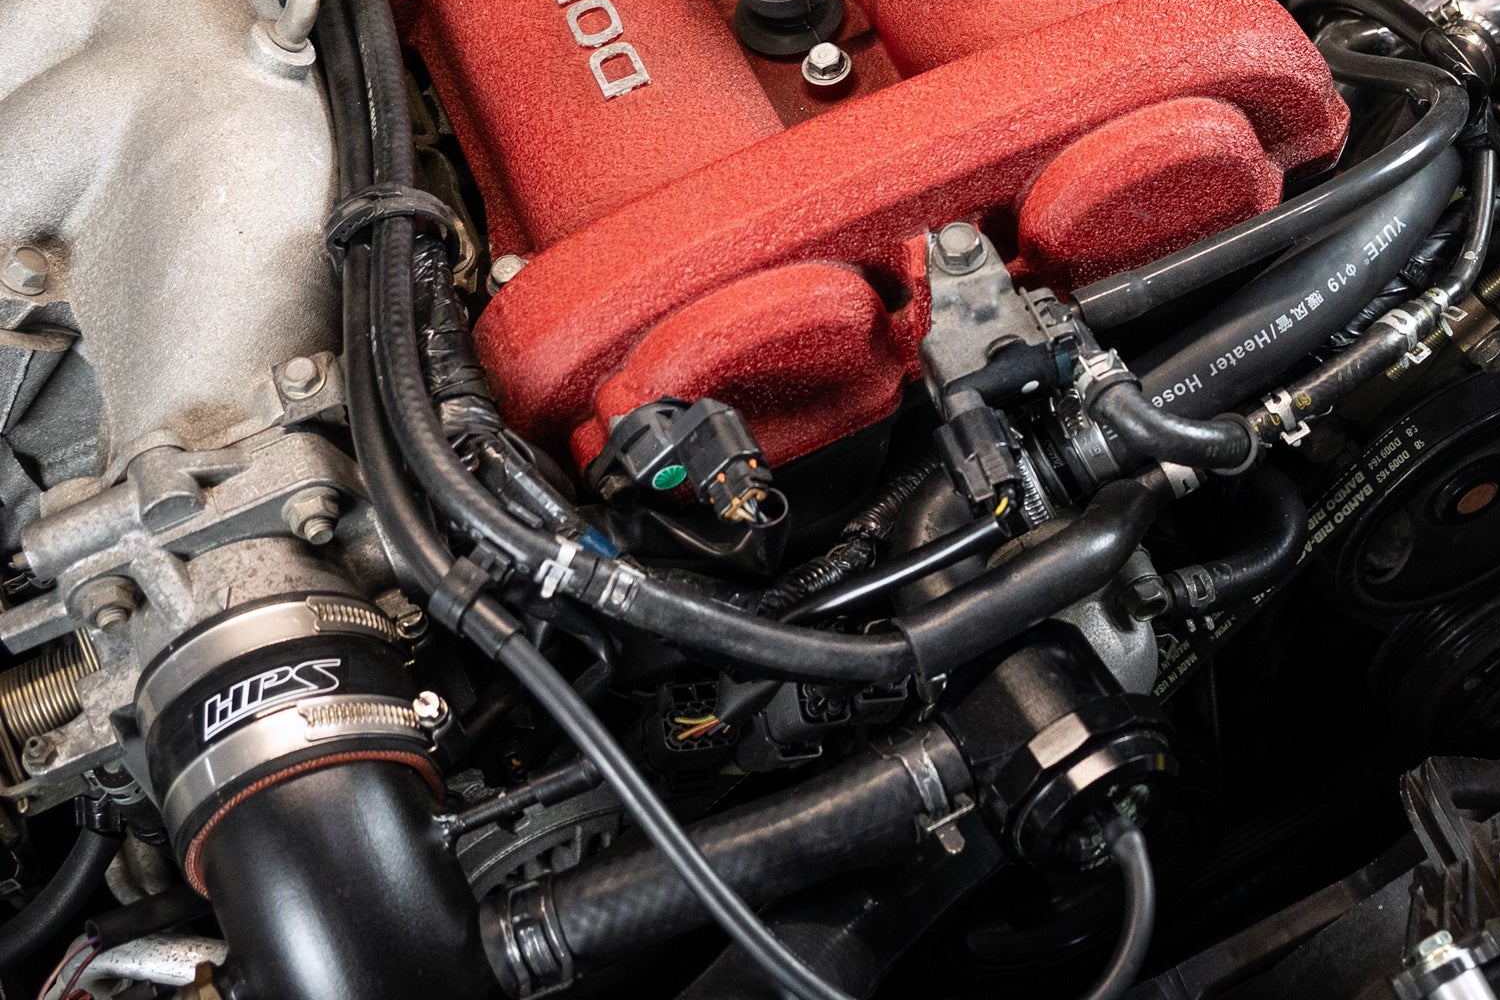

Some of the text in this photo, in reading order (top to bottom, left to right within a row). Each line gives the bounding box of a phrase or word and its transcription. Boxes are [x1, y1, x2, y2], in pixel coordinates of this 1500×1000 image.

[1363, 216, 1407, 262] YUTE
[1152, 373, 1204, 409] Hose
[1326, 471, 1366, 511] BANDO
[1334, 483, 1374, 524] BANDO
[1153, 652, 1198, 697] MADE IN USA
[204, 658, 342, 742] HPS
